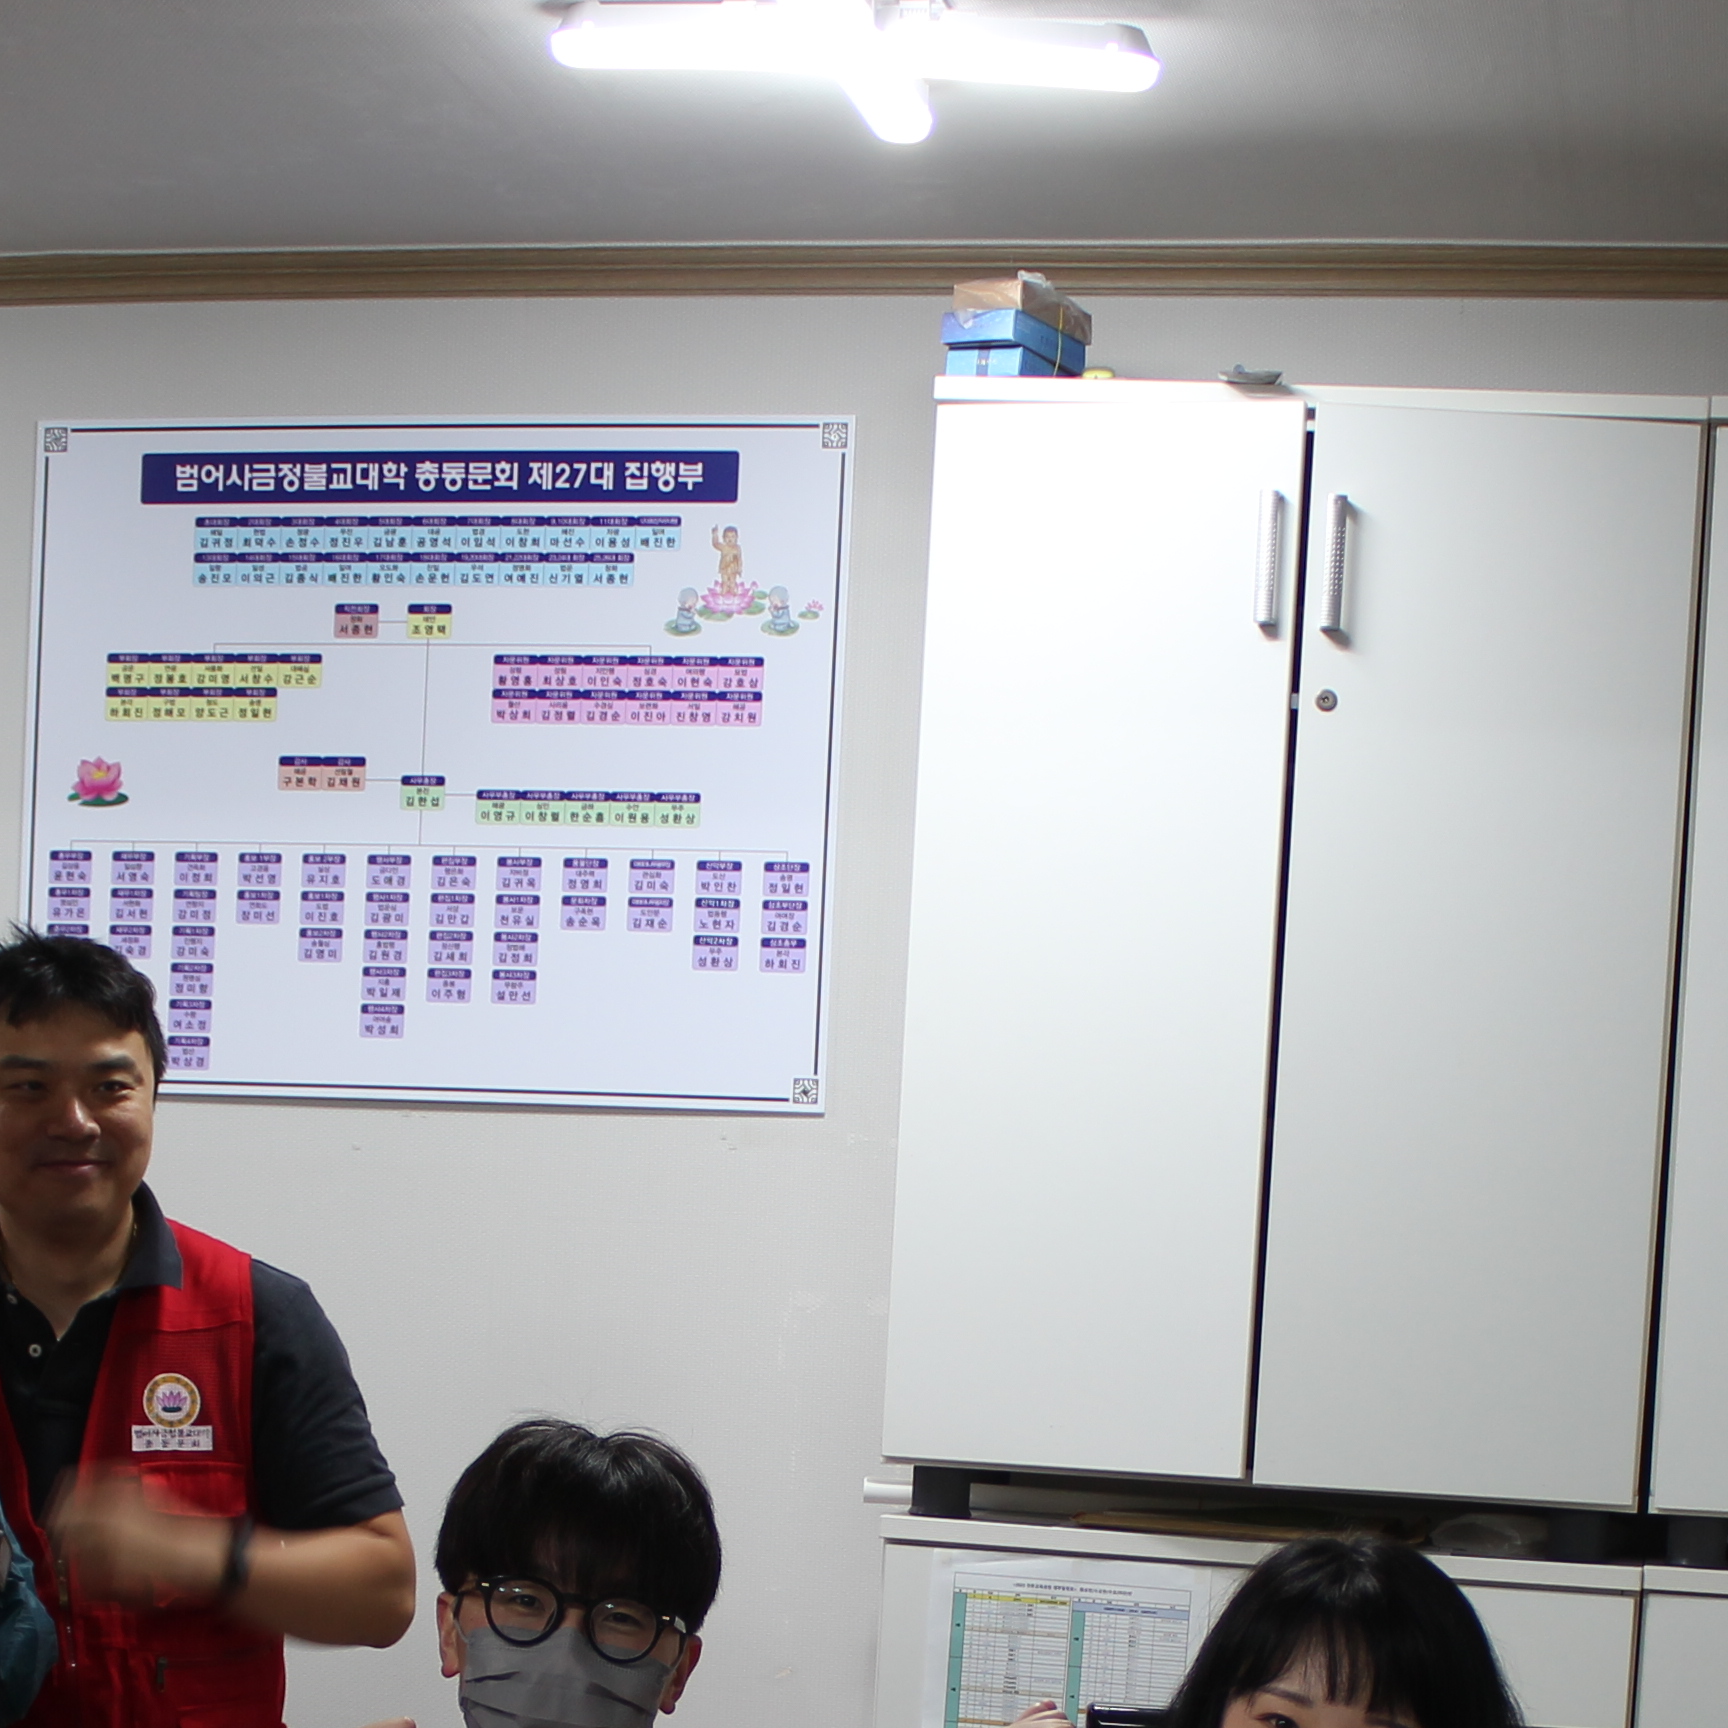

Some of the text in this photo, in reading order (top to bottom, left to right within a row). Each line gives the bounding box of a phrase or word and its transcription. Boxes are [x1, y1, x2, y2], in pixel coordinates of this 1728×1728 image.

[175, 460, 703, 492] 범어사금정불교대학 총동문회 제27대 집행부
